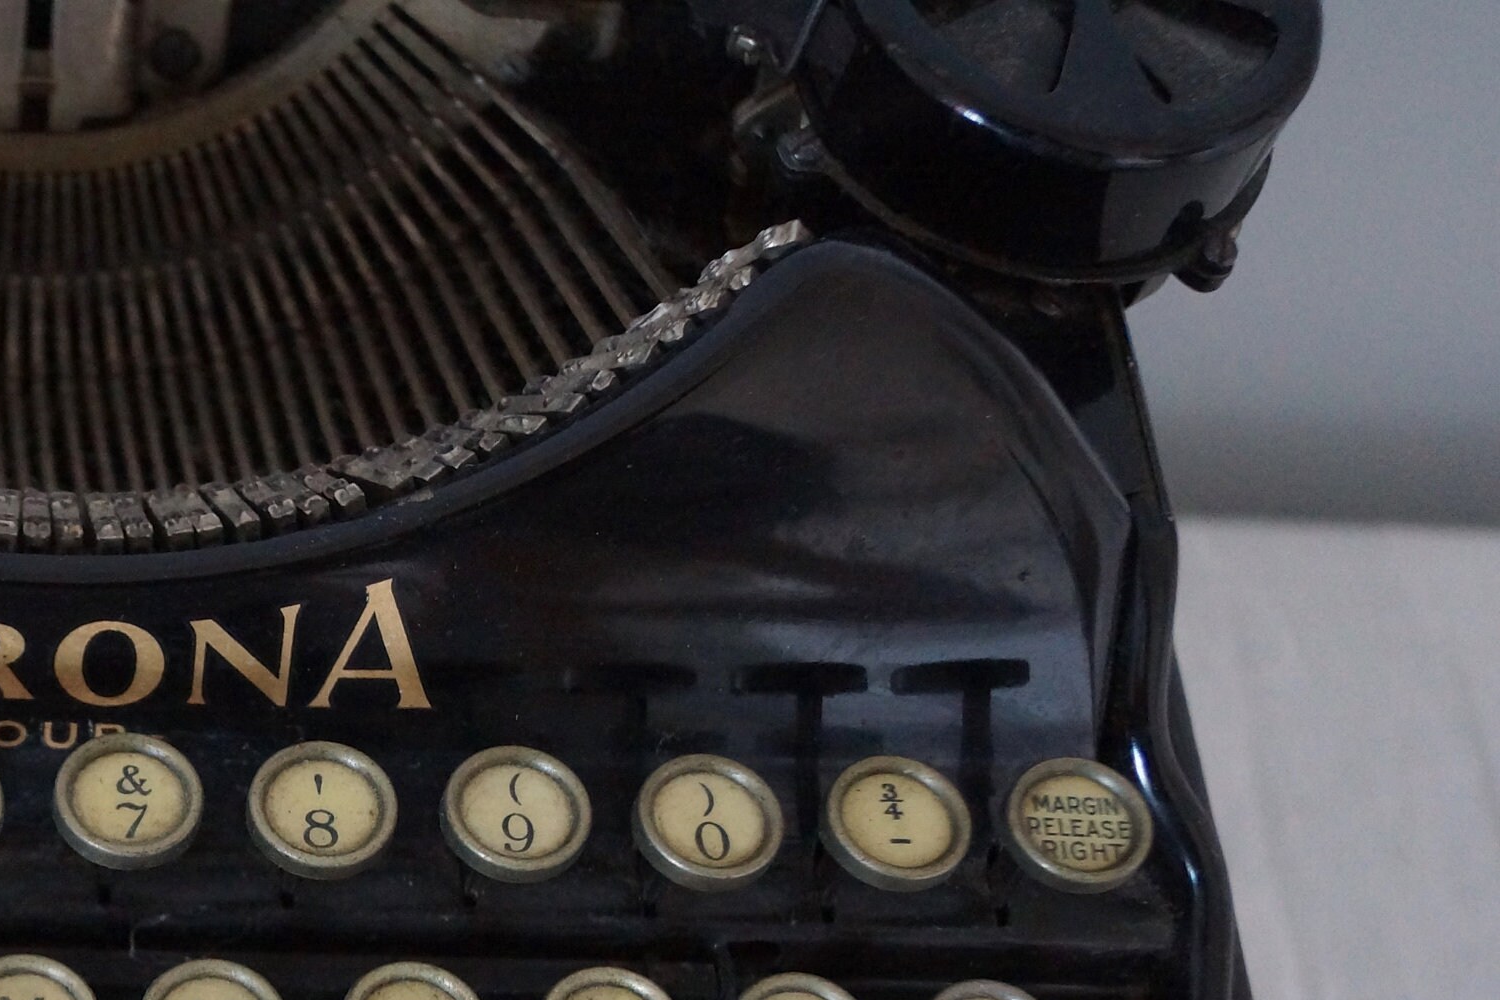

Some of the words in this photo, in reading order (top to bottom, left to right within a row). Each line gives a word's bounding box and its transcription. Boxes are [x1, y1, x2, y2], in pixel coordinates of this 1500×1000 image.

[115, 764, 153, 796] &
[509, 772, 522, 806] (
[700, 782, 715, 817] )
[1032, 794, 1119, 816] MARGIN
[115, 801, 148, 839] 7
[302, 808, 339, 850] 8
[501, 812, 536, 854] 9
[1025, 816, 1132, 839] RELEASE
[1041, 839, 1125, 861] RIGHT
